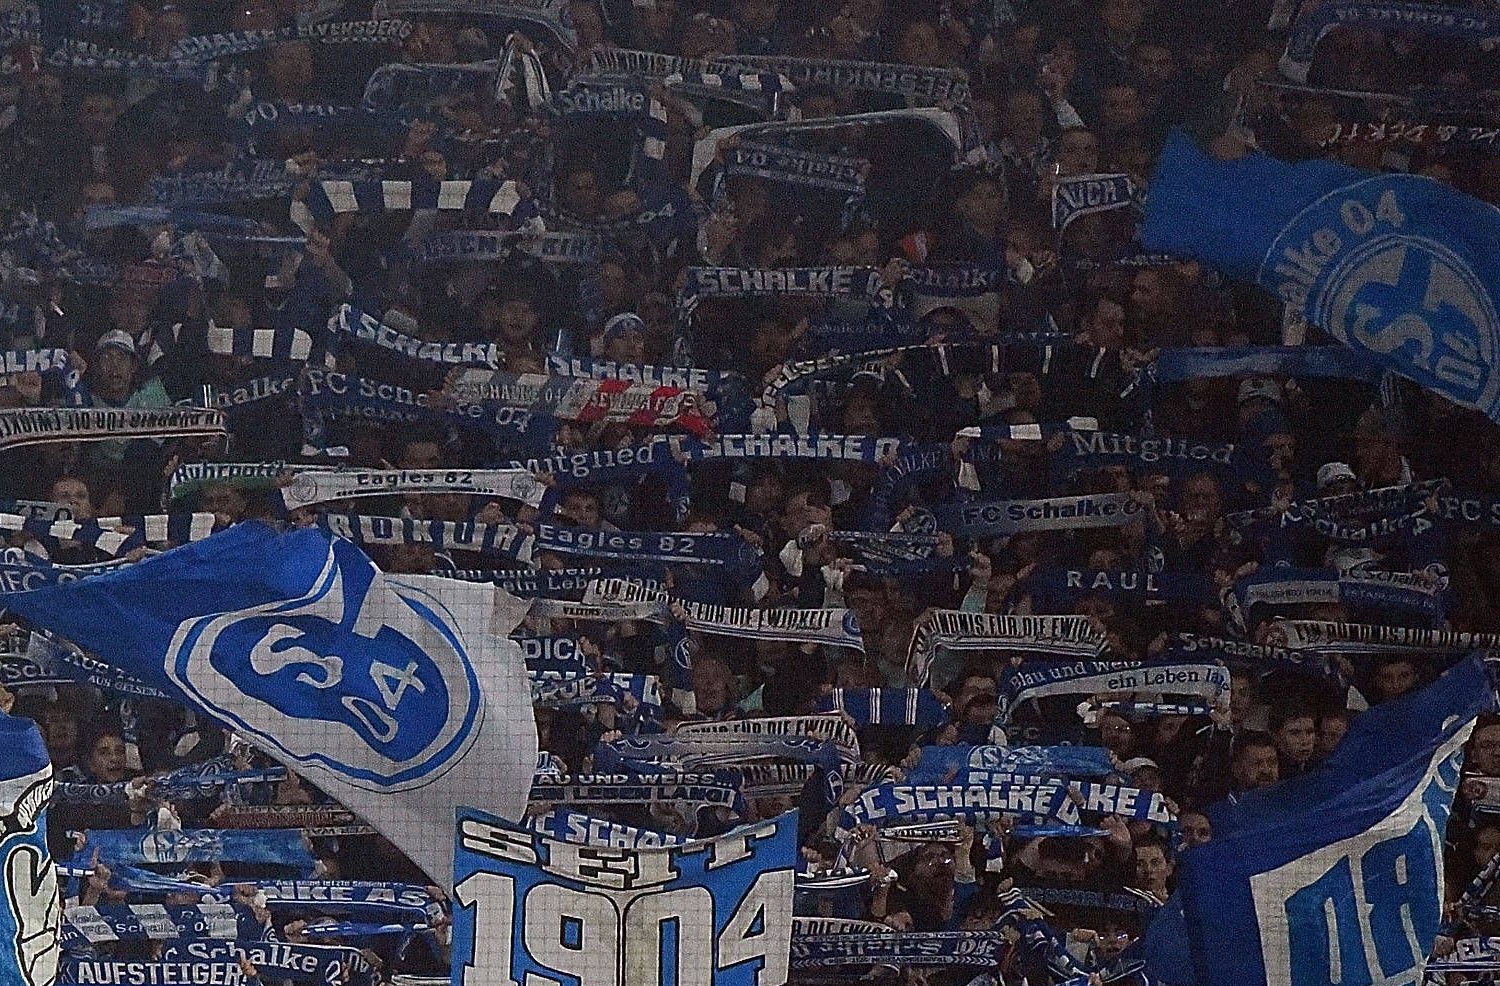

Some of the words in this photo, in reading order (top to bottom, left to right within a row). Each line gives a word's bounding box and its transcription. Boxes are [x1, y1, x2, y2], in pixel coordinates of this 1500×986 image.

[703, 436, 865, 458] SCHALKE
[1072, 432, 1235, 465] Mitglied
[358, 471, 435, 487] Eagles
[445, 471, 473, 484] 82
[539, 525, 642, 551] Eagles
[660, 537, 695, 553] 82
[1067, 569, 1160, 593] RAUL
[896, 783, 1056, 816] SCHALKE
[462, 818, 776, 890] SEIT
